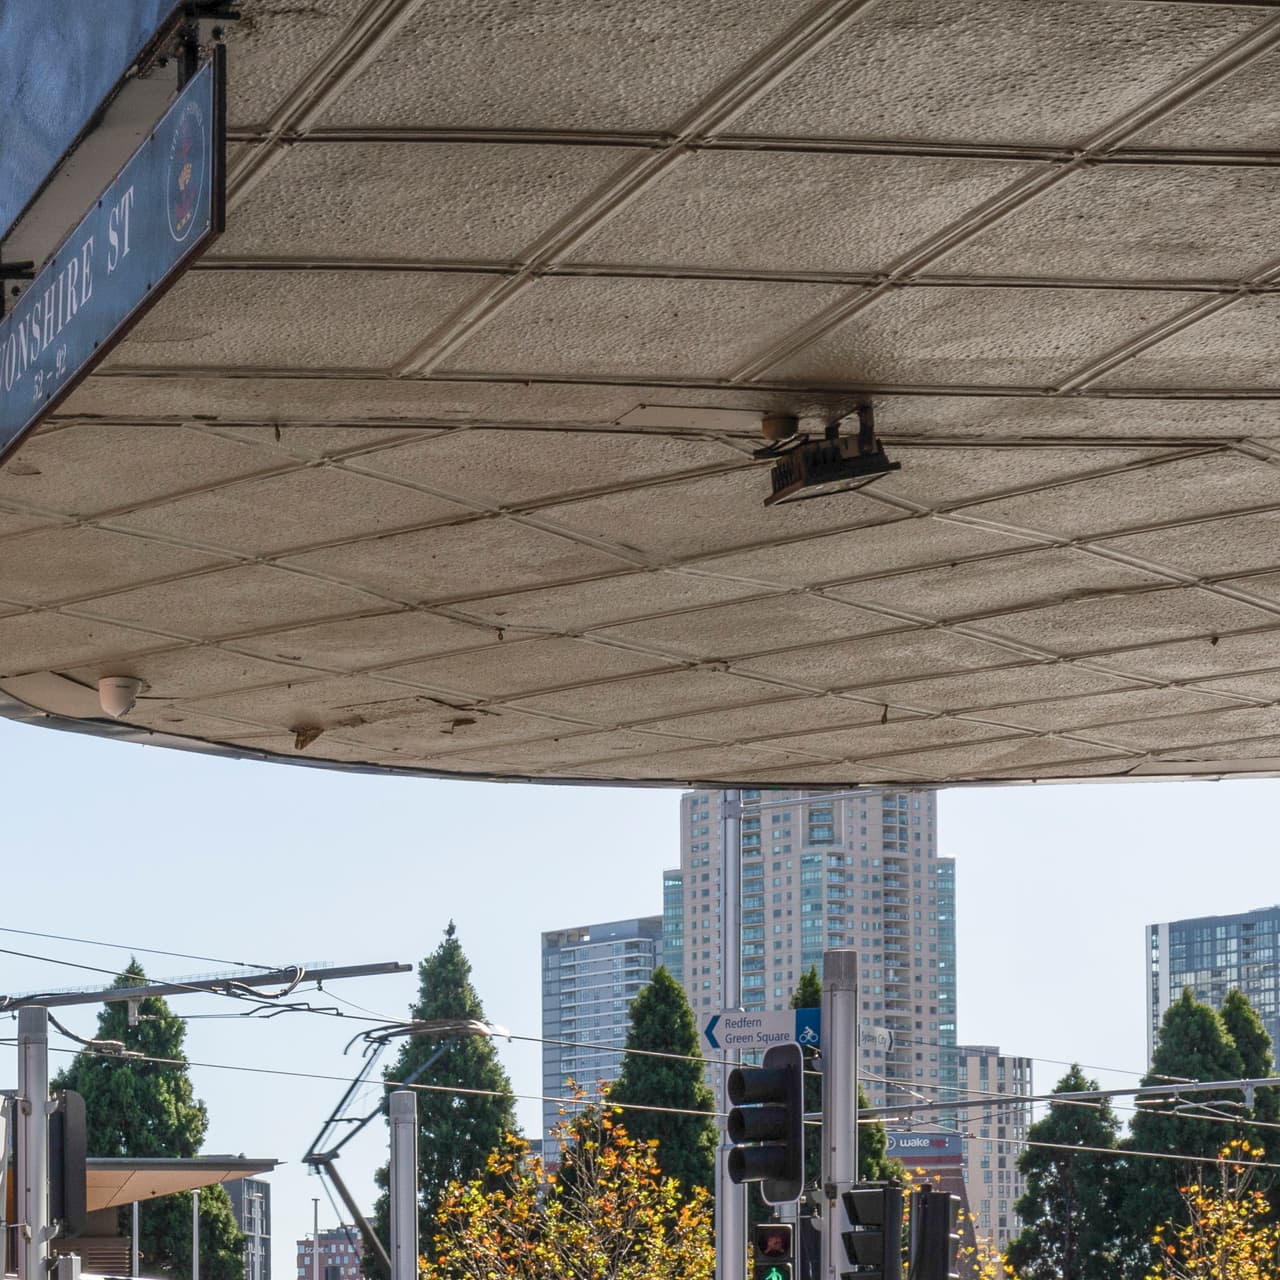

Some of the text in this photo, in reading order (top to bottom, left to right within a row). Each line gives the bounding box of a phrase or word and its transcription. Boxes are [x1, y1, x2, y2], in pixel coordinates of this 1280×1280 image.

[107, 185, 134, 275] ST
[725, 1018, 762, 1029] Redfern
[725, 1031, 790, 1045] Green Square
